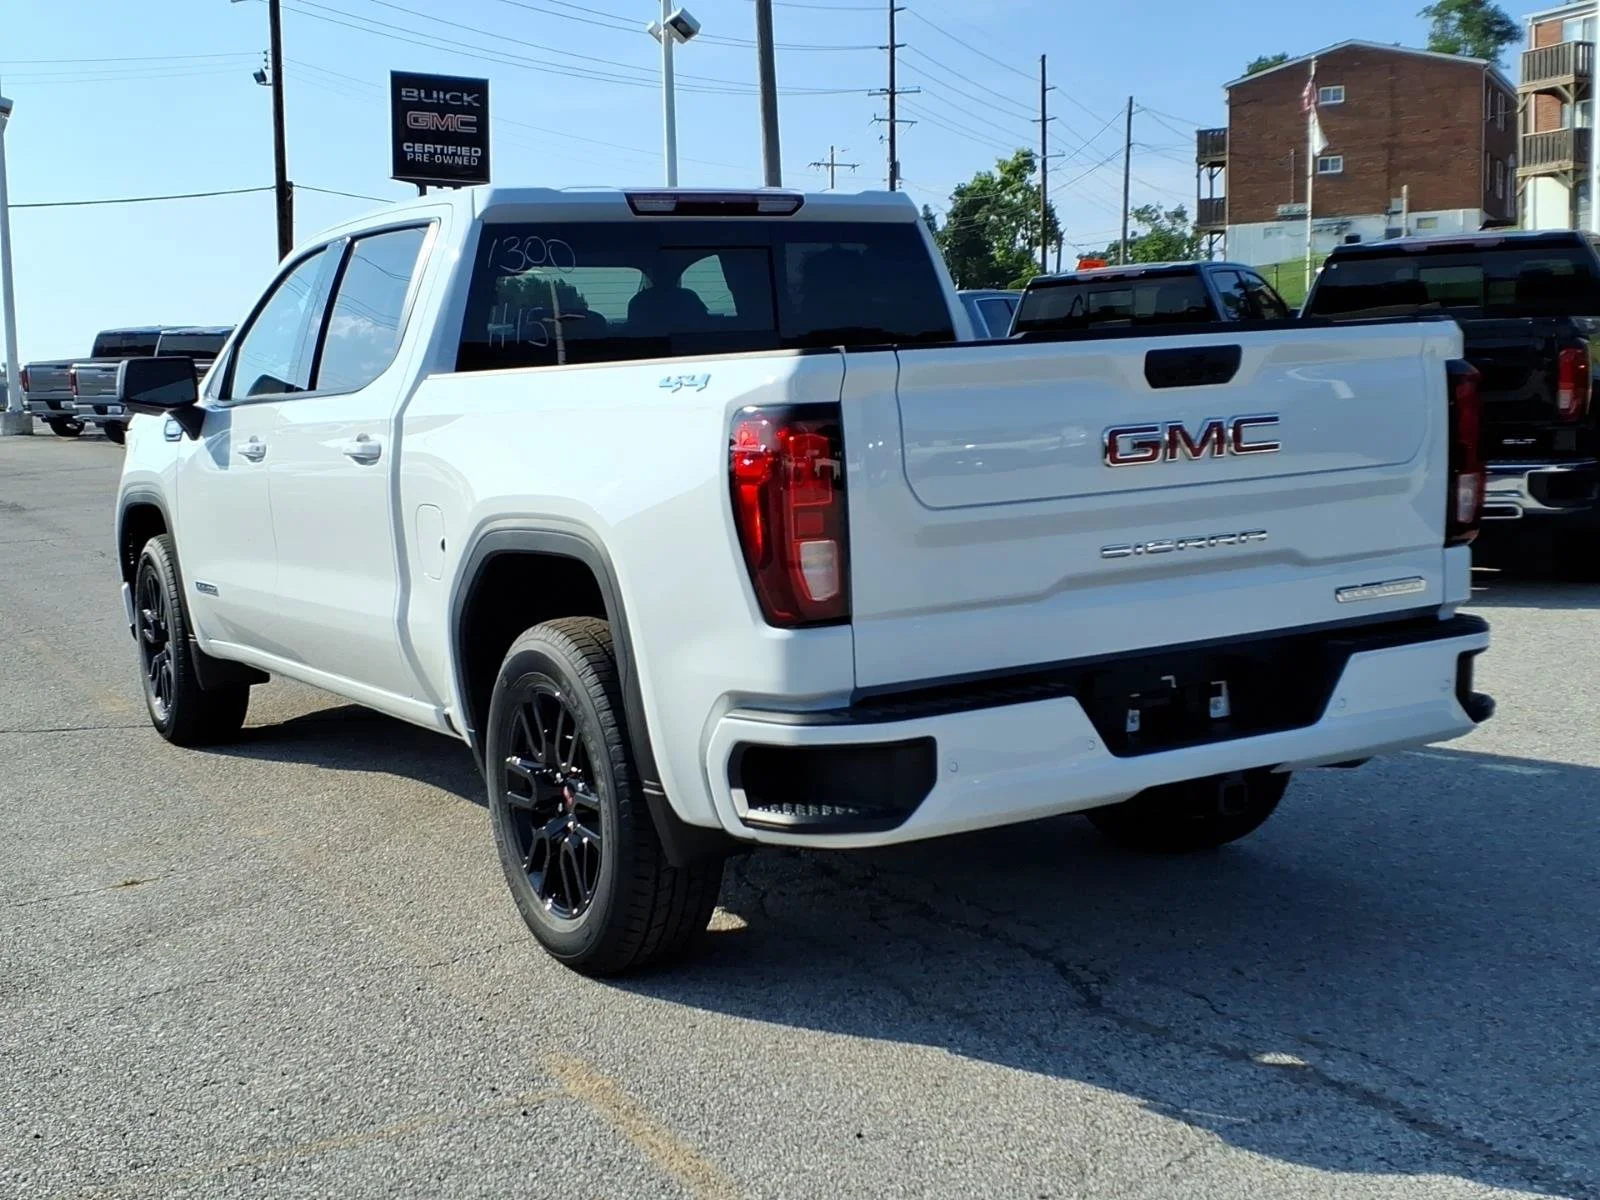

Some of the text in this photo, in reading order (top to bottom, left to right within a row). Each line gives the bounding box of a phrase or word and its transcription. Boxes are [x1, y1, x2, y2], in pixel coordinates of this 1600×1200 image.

[401, 87, 481, 107] BUICK
[406, 110, 477, 133] GMC
[402, 142, 482, 157] CERTIFIED
[407, 153, 478, 166] PRE-OWNED
[487, 235, 576, 274] 1300
[1102, 412, 1281, 467] GMC
[1100, 528, 1268, 559] SIERRA
